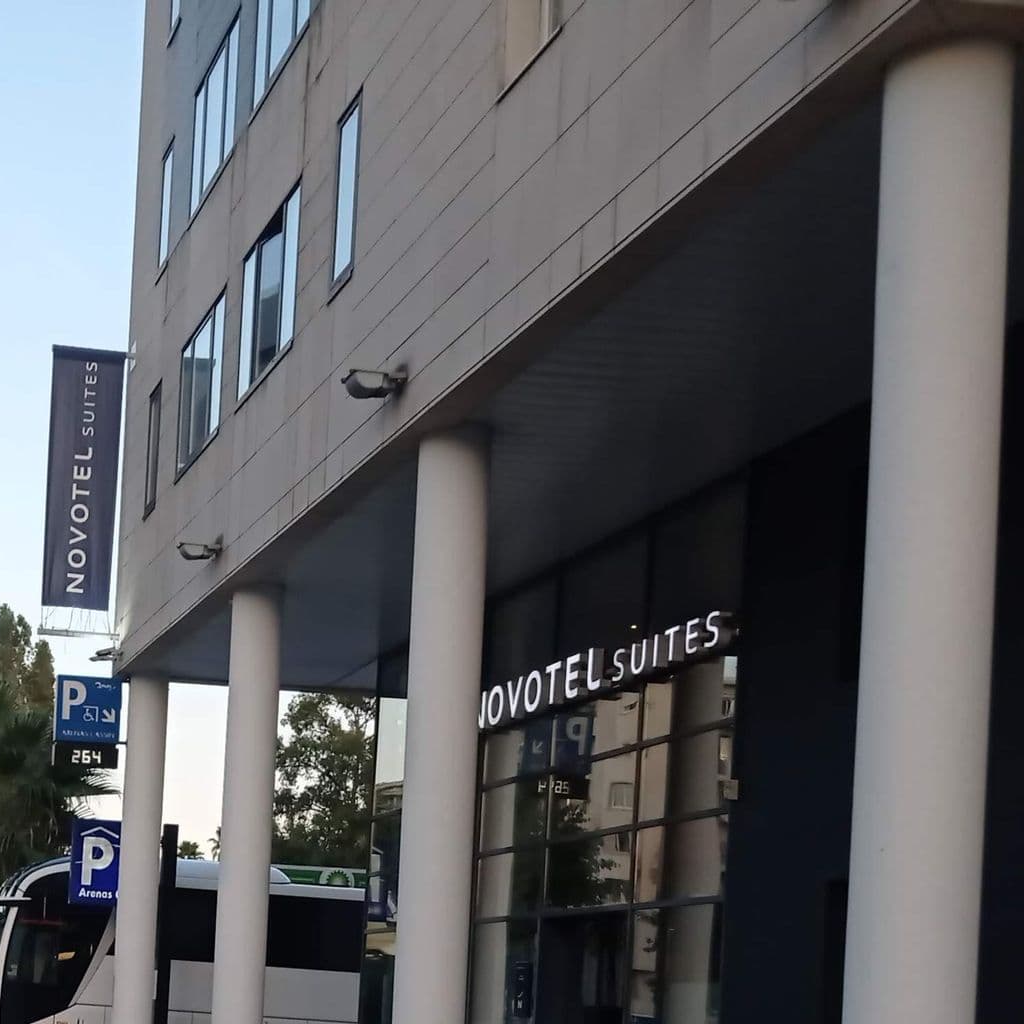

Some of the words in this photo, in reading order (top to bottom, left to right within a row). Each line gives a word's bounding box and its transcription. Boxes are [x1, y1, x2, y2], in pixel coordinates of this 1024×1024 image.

[66, 446, 93, 594] NOVOTEL
[82, 360, 98, 437] SUITES
[611, 610, 720, 683] SUITES
[61, 680, 87, 720] P
[71, 749, 102, 764] 264
[80, 836, 114, 886] P
[78, 887, 113, 900] Arenas
